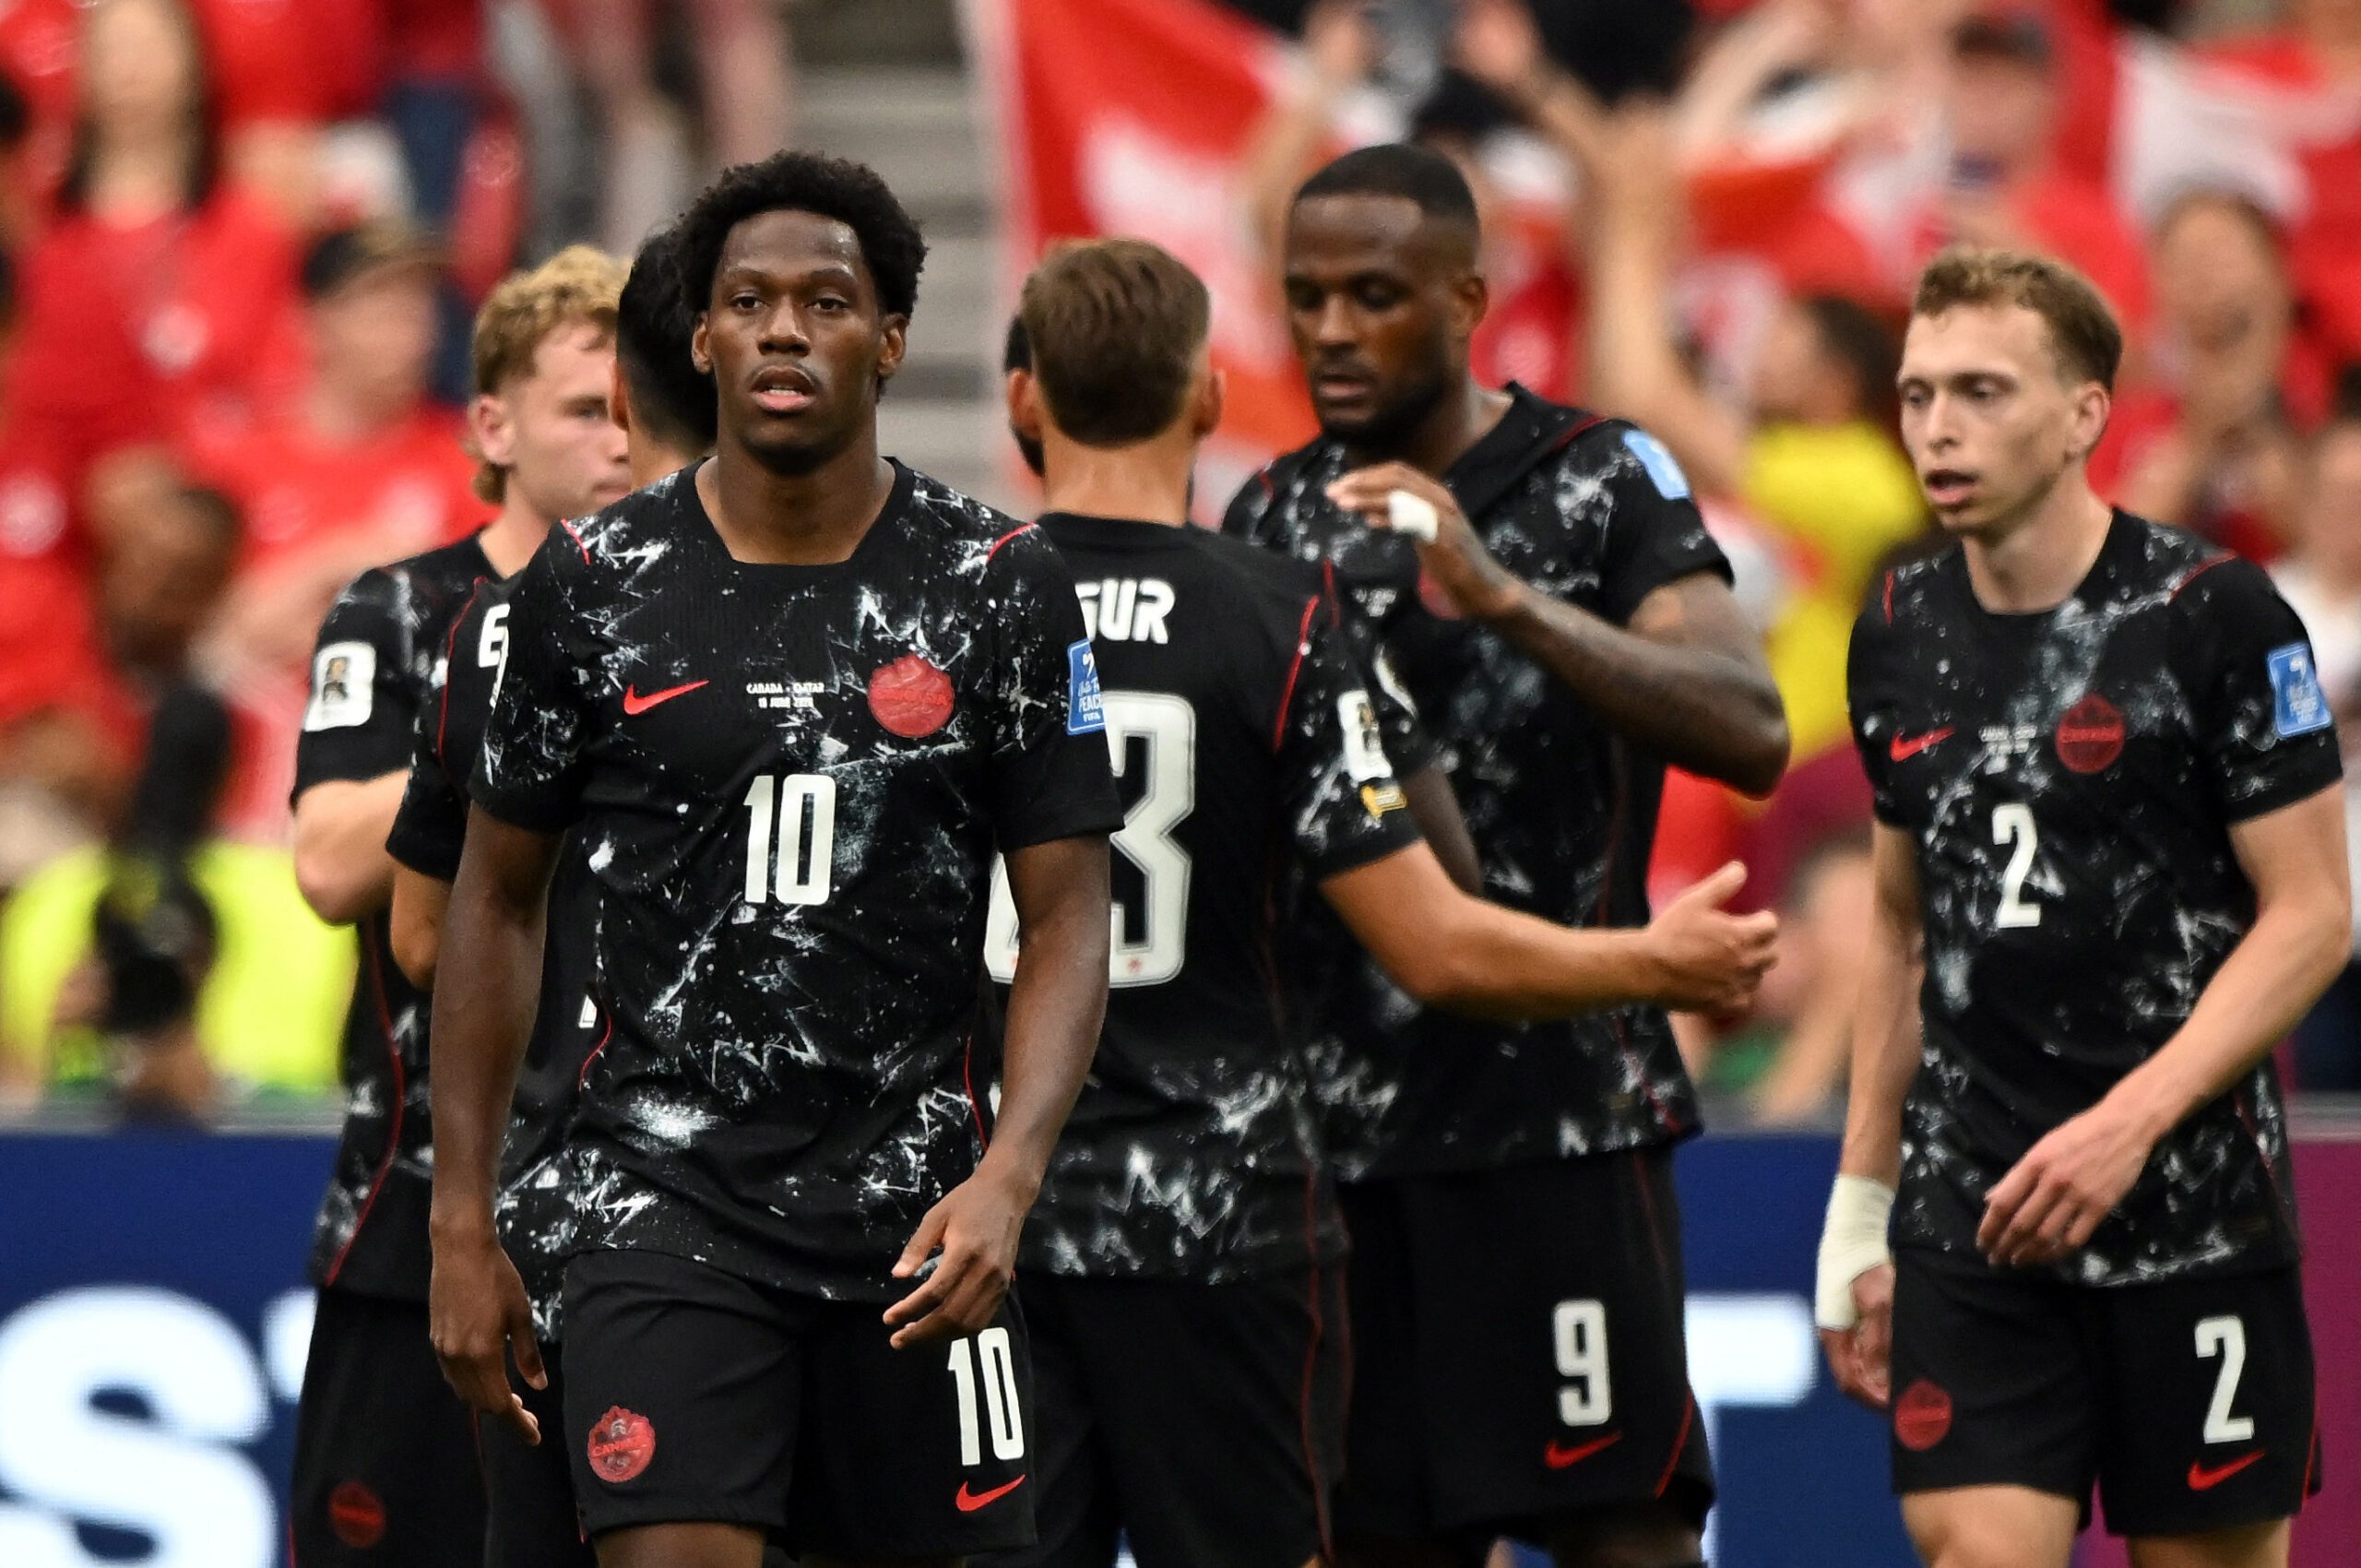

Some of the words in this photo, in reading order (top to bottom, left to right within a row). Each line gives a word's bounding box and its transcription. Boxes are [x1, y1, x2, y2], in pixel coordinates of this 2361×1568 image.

[743, 774, 836, 906] 10
[984, 690, 1196, 989] 3
[1992, 802, 2042, 929] 2
[947, 1326, 1024, 1466] 10
[1552, 1299, 1611, 1426] 9
[2194, 1314, 2254, 1443] 2
